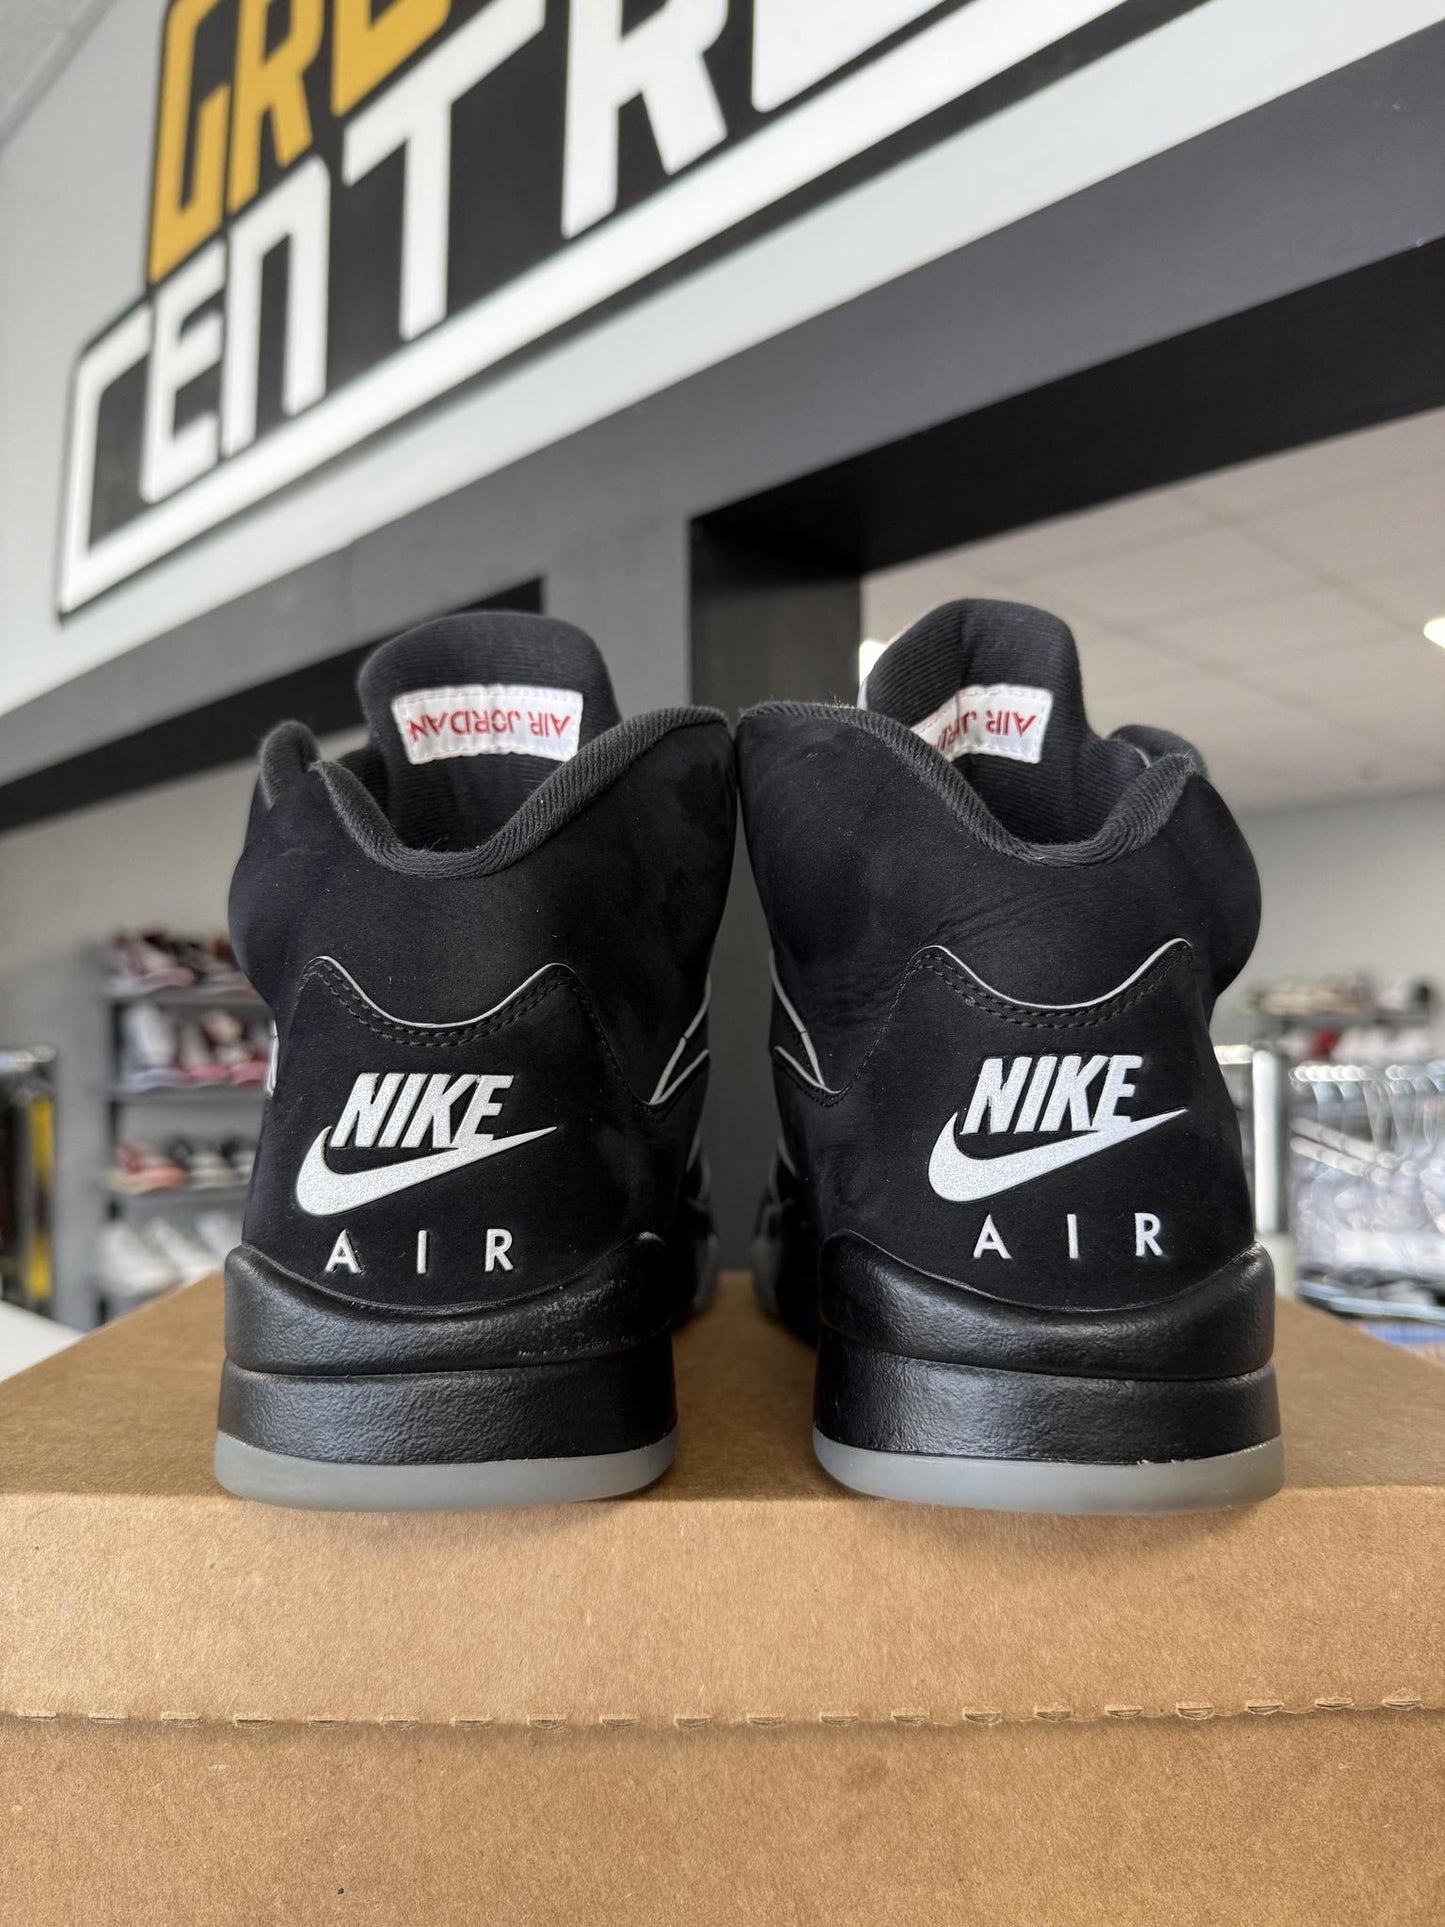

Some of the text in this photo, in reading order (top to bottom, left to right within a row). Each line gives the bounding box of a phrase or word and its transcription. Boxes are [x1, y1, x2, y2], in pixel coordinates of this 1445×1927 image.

[408, 709, 570, 742] AIR JORDAN
[985, 709, 1036, 739] AIR
[330, 1072, 514, 1149] NIKE
[959, 1054, 1143, 1135] NIKE
[325, 1228, 514, 1274] AIR
[973, 1212, 1164, 1259] AIR
